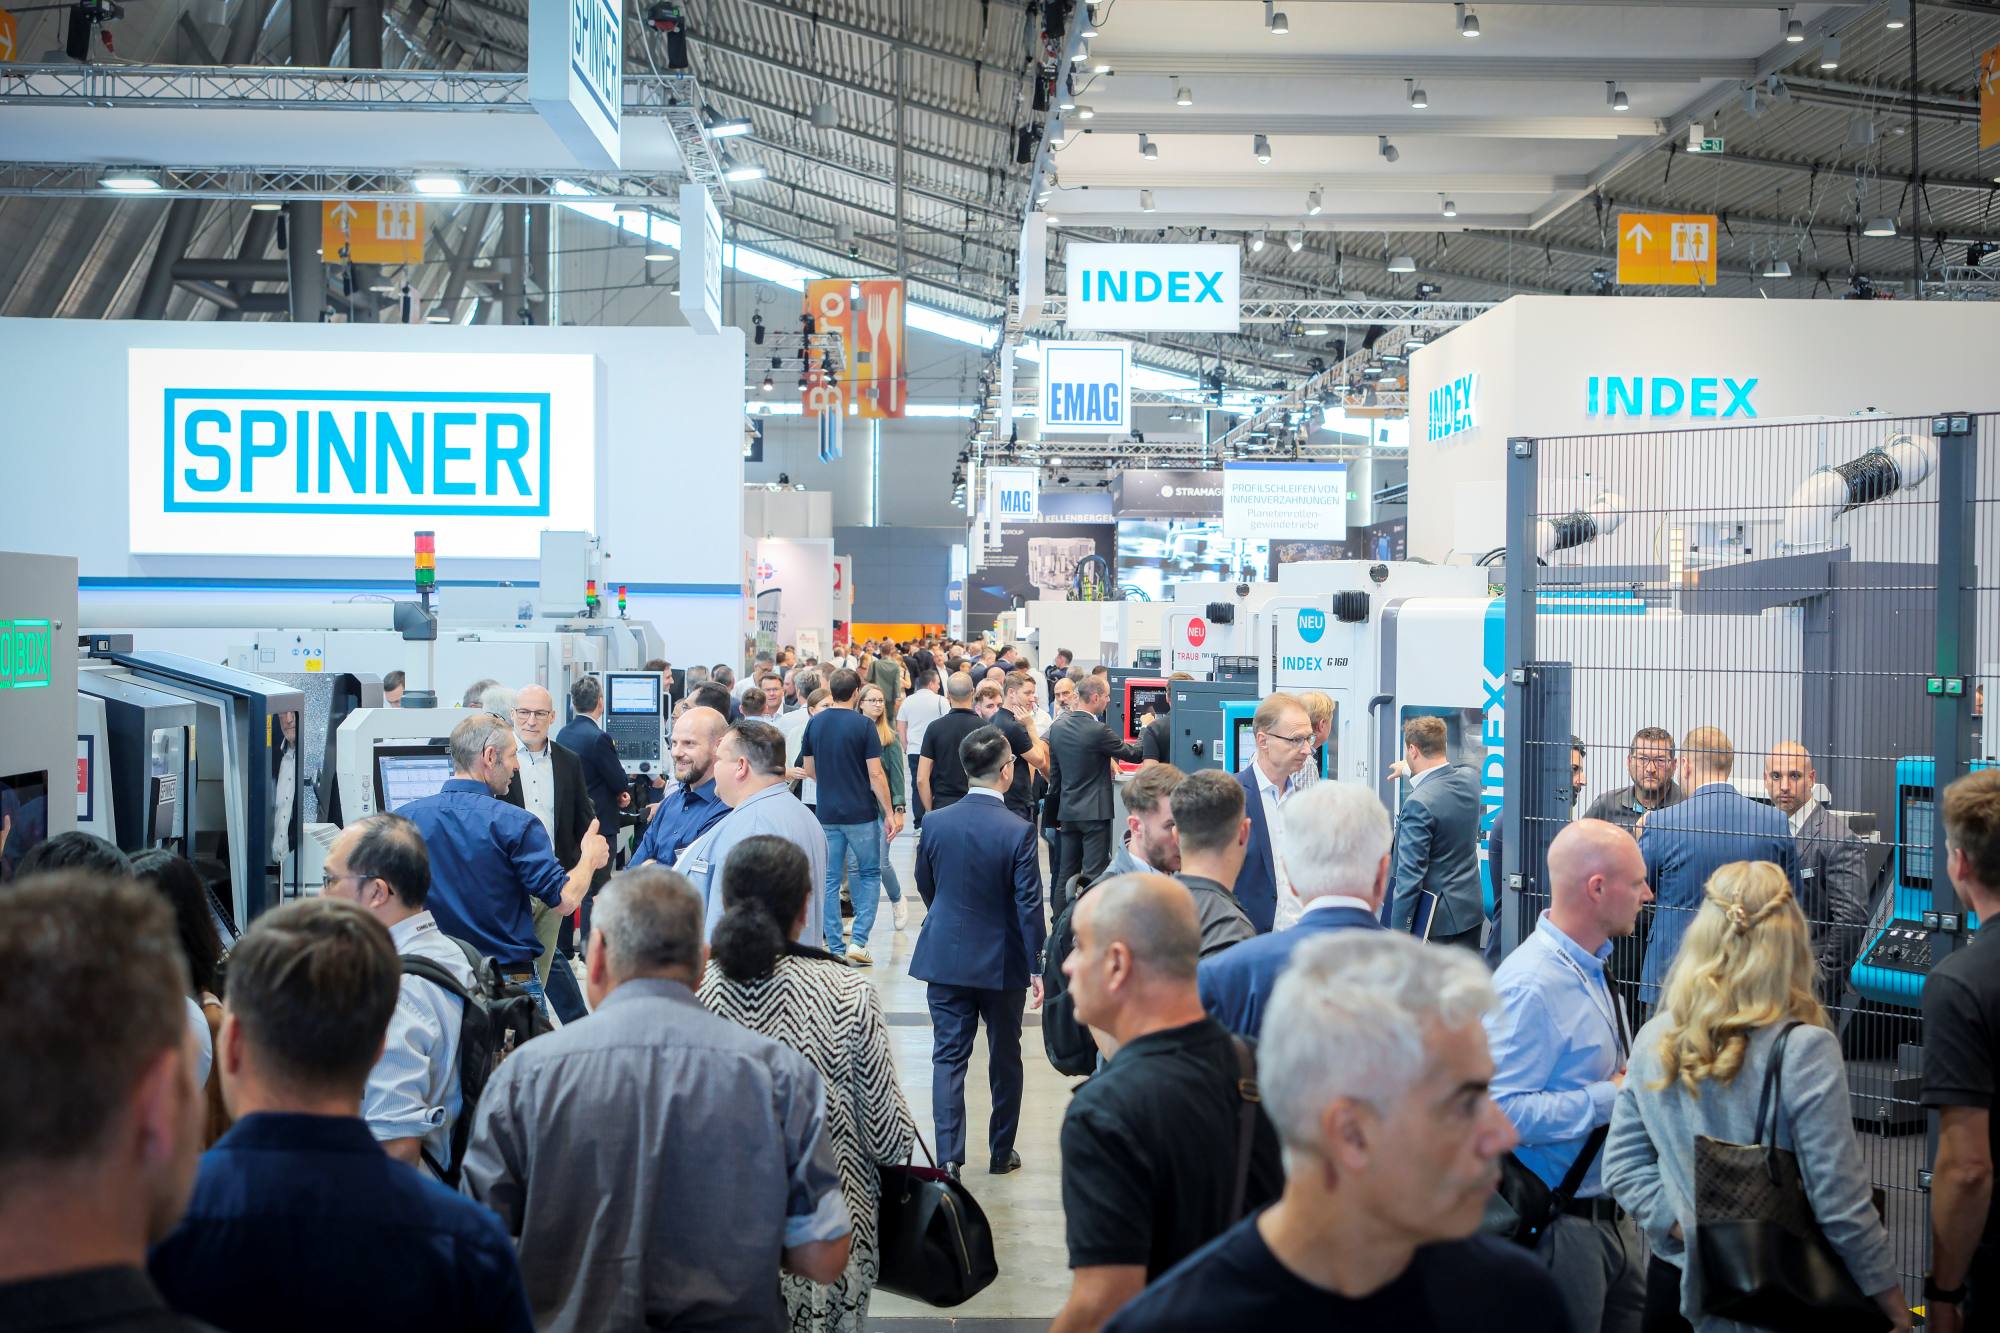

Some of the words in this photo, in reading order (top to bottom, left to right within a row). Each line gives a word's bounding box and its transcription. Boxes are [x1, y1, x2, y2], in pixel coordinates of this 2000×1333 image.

[1082, 270, 1223, 303] INDEX
[1051, 382, 1119, 421] EMAG
[1428, 373, 1473, 442] INDEX
[1586, 376, 1758, 417] INDEX
[184, 409, 532, 496] SPINNER
[1230, 495, 1340, 505] INNENVERZAHNUNGEN
[1232, 483, 1316, 494] PROFILSCHLEIFEN
[1317, 485, 1339, 494] VON
[1188, 627, 1205, 637] NEU
[1299, 616, 1323, 629] NEU
[15, 631, 47, 676] BOX
[1177, 652, 1199, 661] TRAUB
[1282, 656, 1322, 671] INDEX
[1327, 657, 1333, 667] G
[1334, 657, 1348, 667] 160
